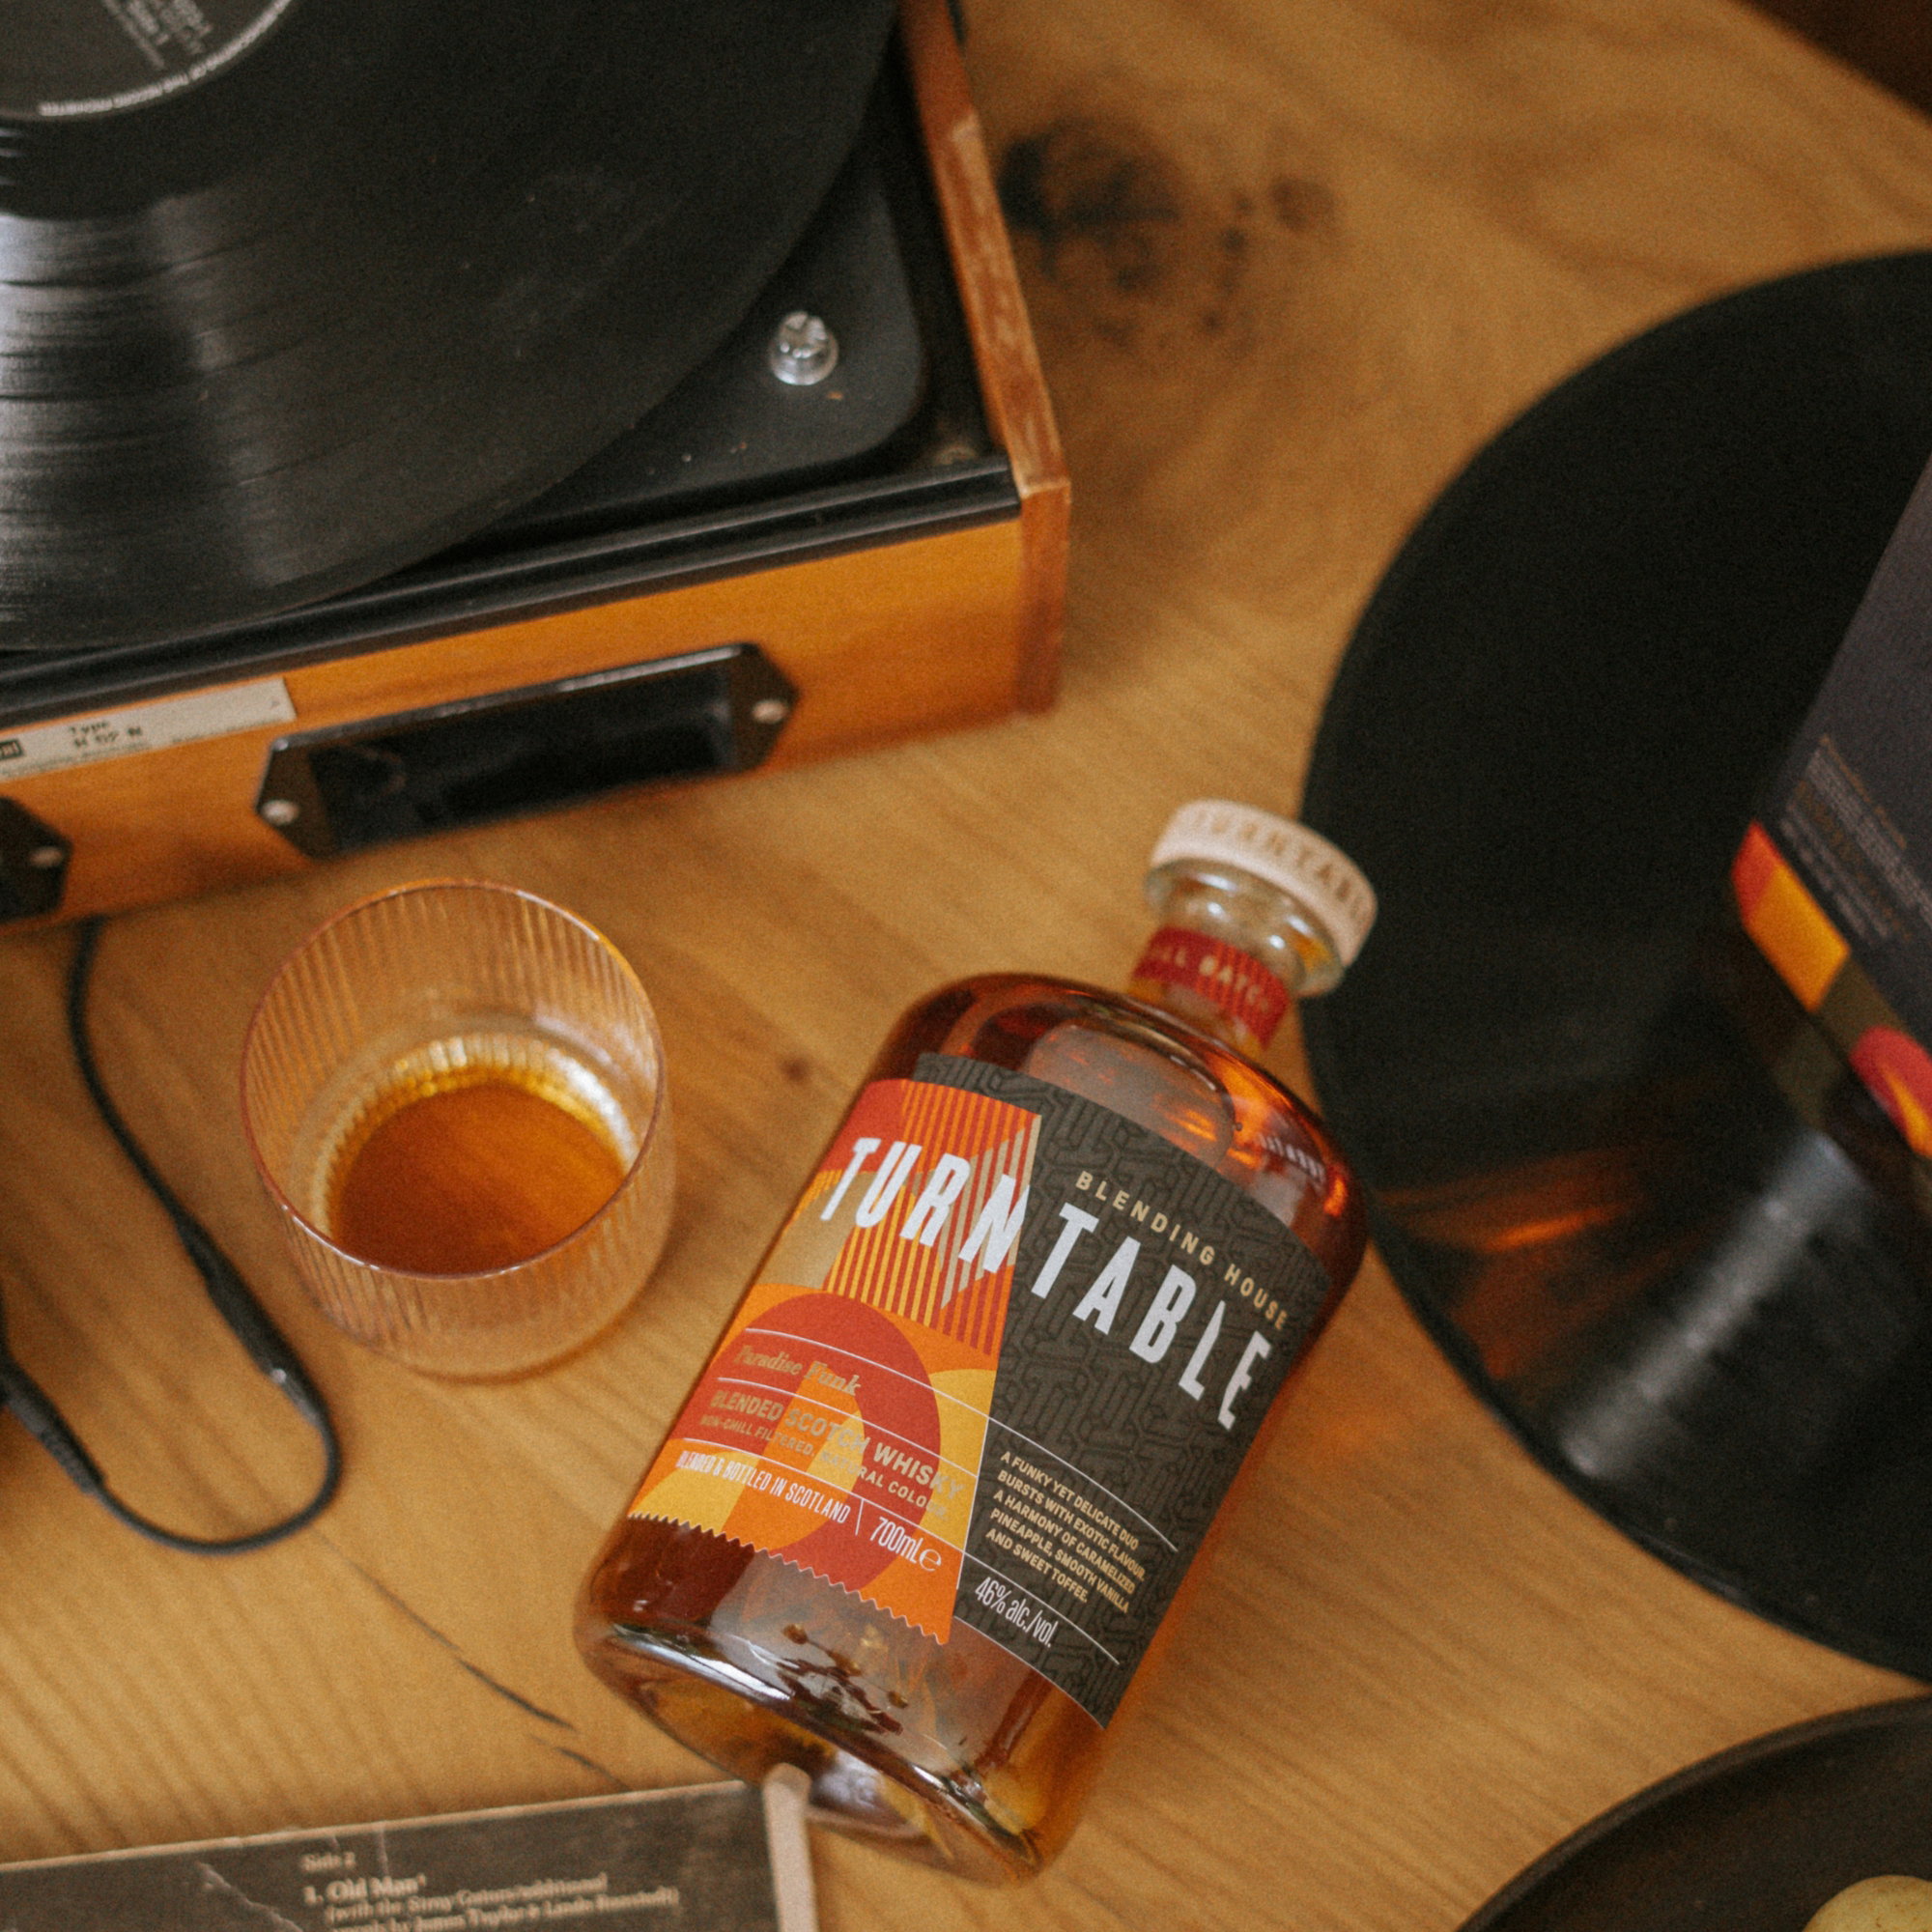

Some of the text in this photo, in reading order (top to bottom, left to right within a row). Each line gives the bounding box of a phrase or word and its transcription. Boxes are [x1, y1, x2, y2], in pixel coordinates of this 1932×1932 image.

[1075, 1171, 1288, 1331] BLENDING HOUSE
[733, 1345, 861, 1396] Paradise Funk
[710, 1390, 966, 1500] BLENDED SCOTCH WHISKY
[820, 1451, 885, 1489] NATURAL
[722, 1461, 772, 1492] BOTTLED
[770, 1476, 787, 1496] IN
[785, 1483, 851, 1524] SCOTLAND
[997, 1469, 1044, 1504] BURSTS
[1044, 1498, 1075, 1524] WITH
[1072, 1519, 1110, 1550] EXOTIC
[1000, 1450, 1140, 1550] A FUNKY YET DELICATE DUO
[985, 1528, 1089, 1605] AND SWEET TOFFEE.
[990, 1508, 1130, 1614] PINEAPPLE, SMOOTH VANILLA
[993, 1490, 1137, 1595] A HARMONY OF CARAMELIZED
[975, 1577, 1011, 1616] 46%
[326, 1877, 368, 1904] Old
